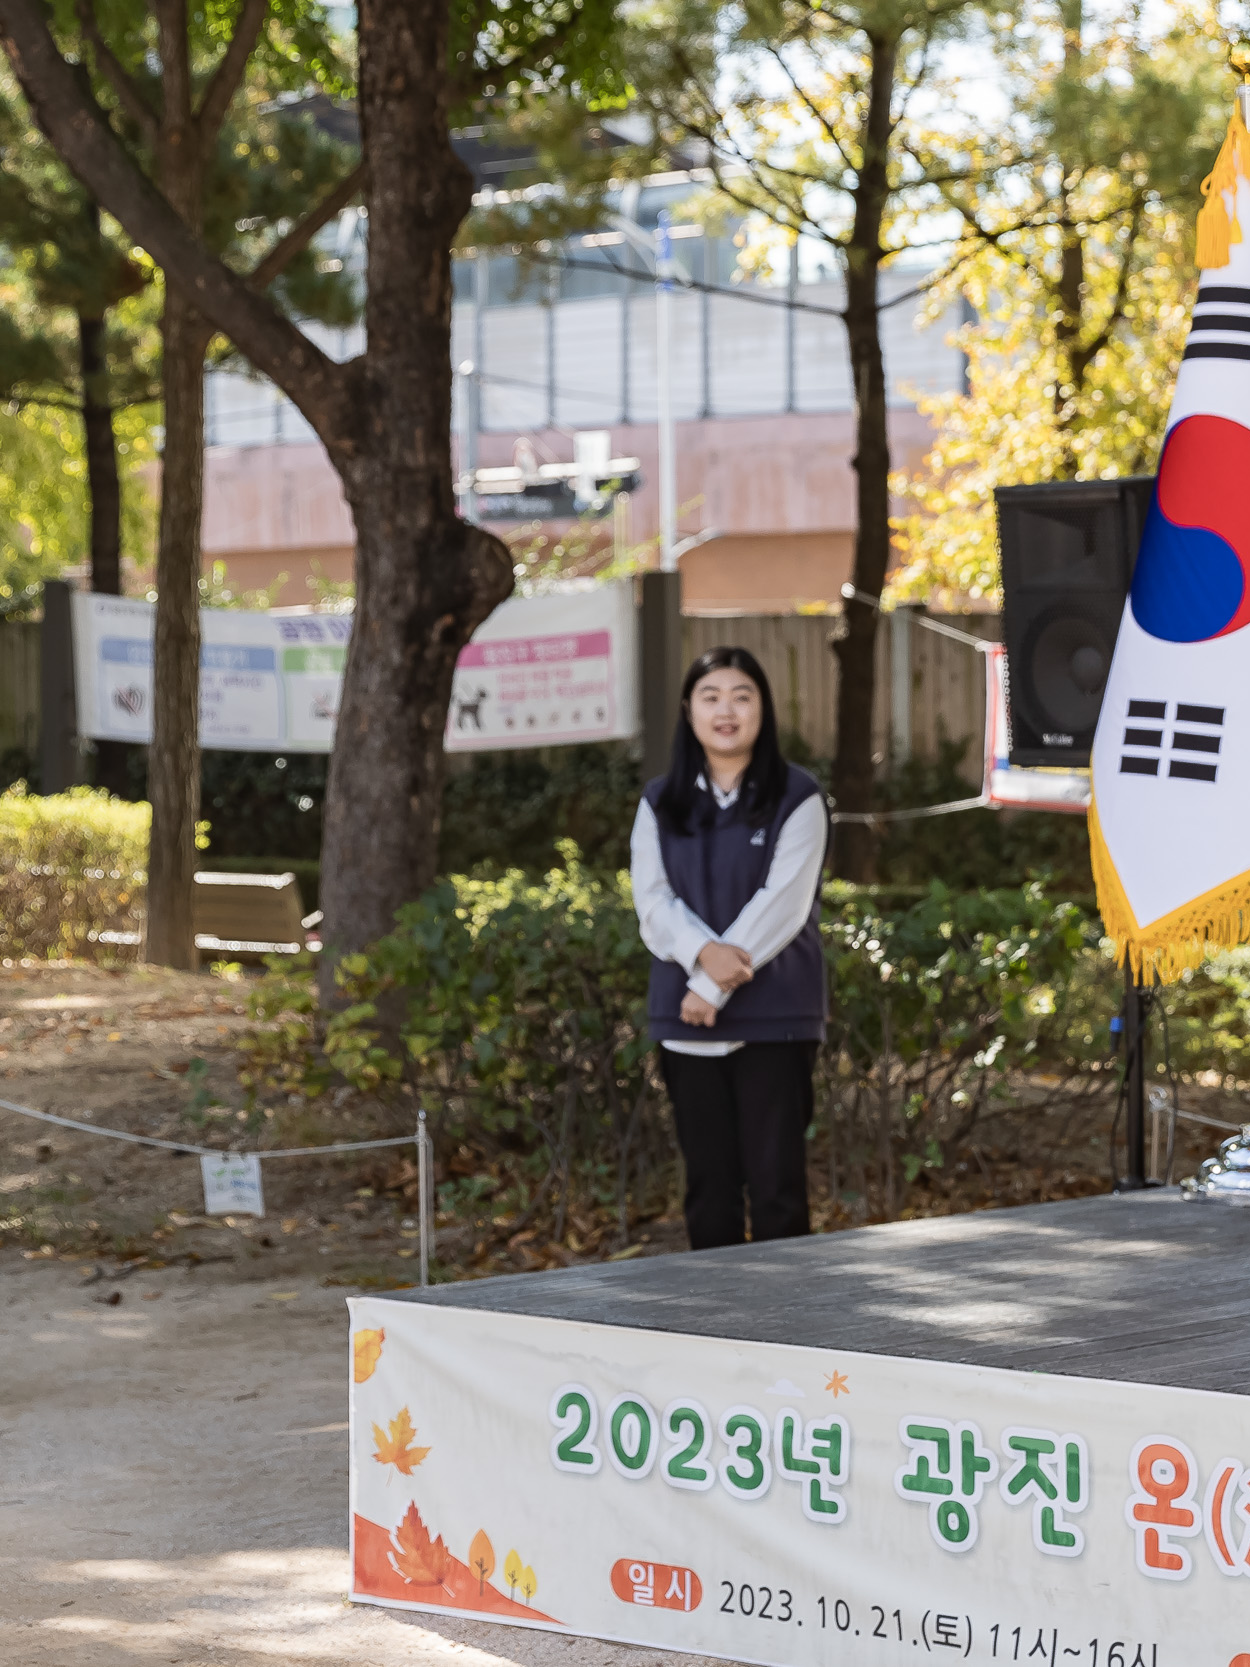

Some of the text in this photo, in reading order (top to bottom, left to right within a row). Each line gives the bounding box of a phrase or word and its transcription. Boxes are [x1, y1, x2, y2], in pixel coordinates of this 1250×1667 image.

[555, 1391, 843, 1515] 2023년
[901, 1423, 1081, 1547] 광진
[627, 1560, 694, 1613] 일시
